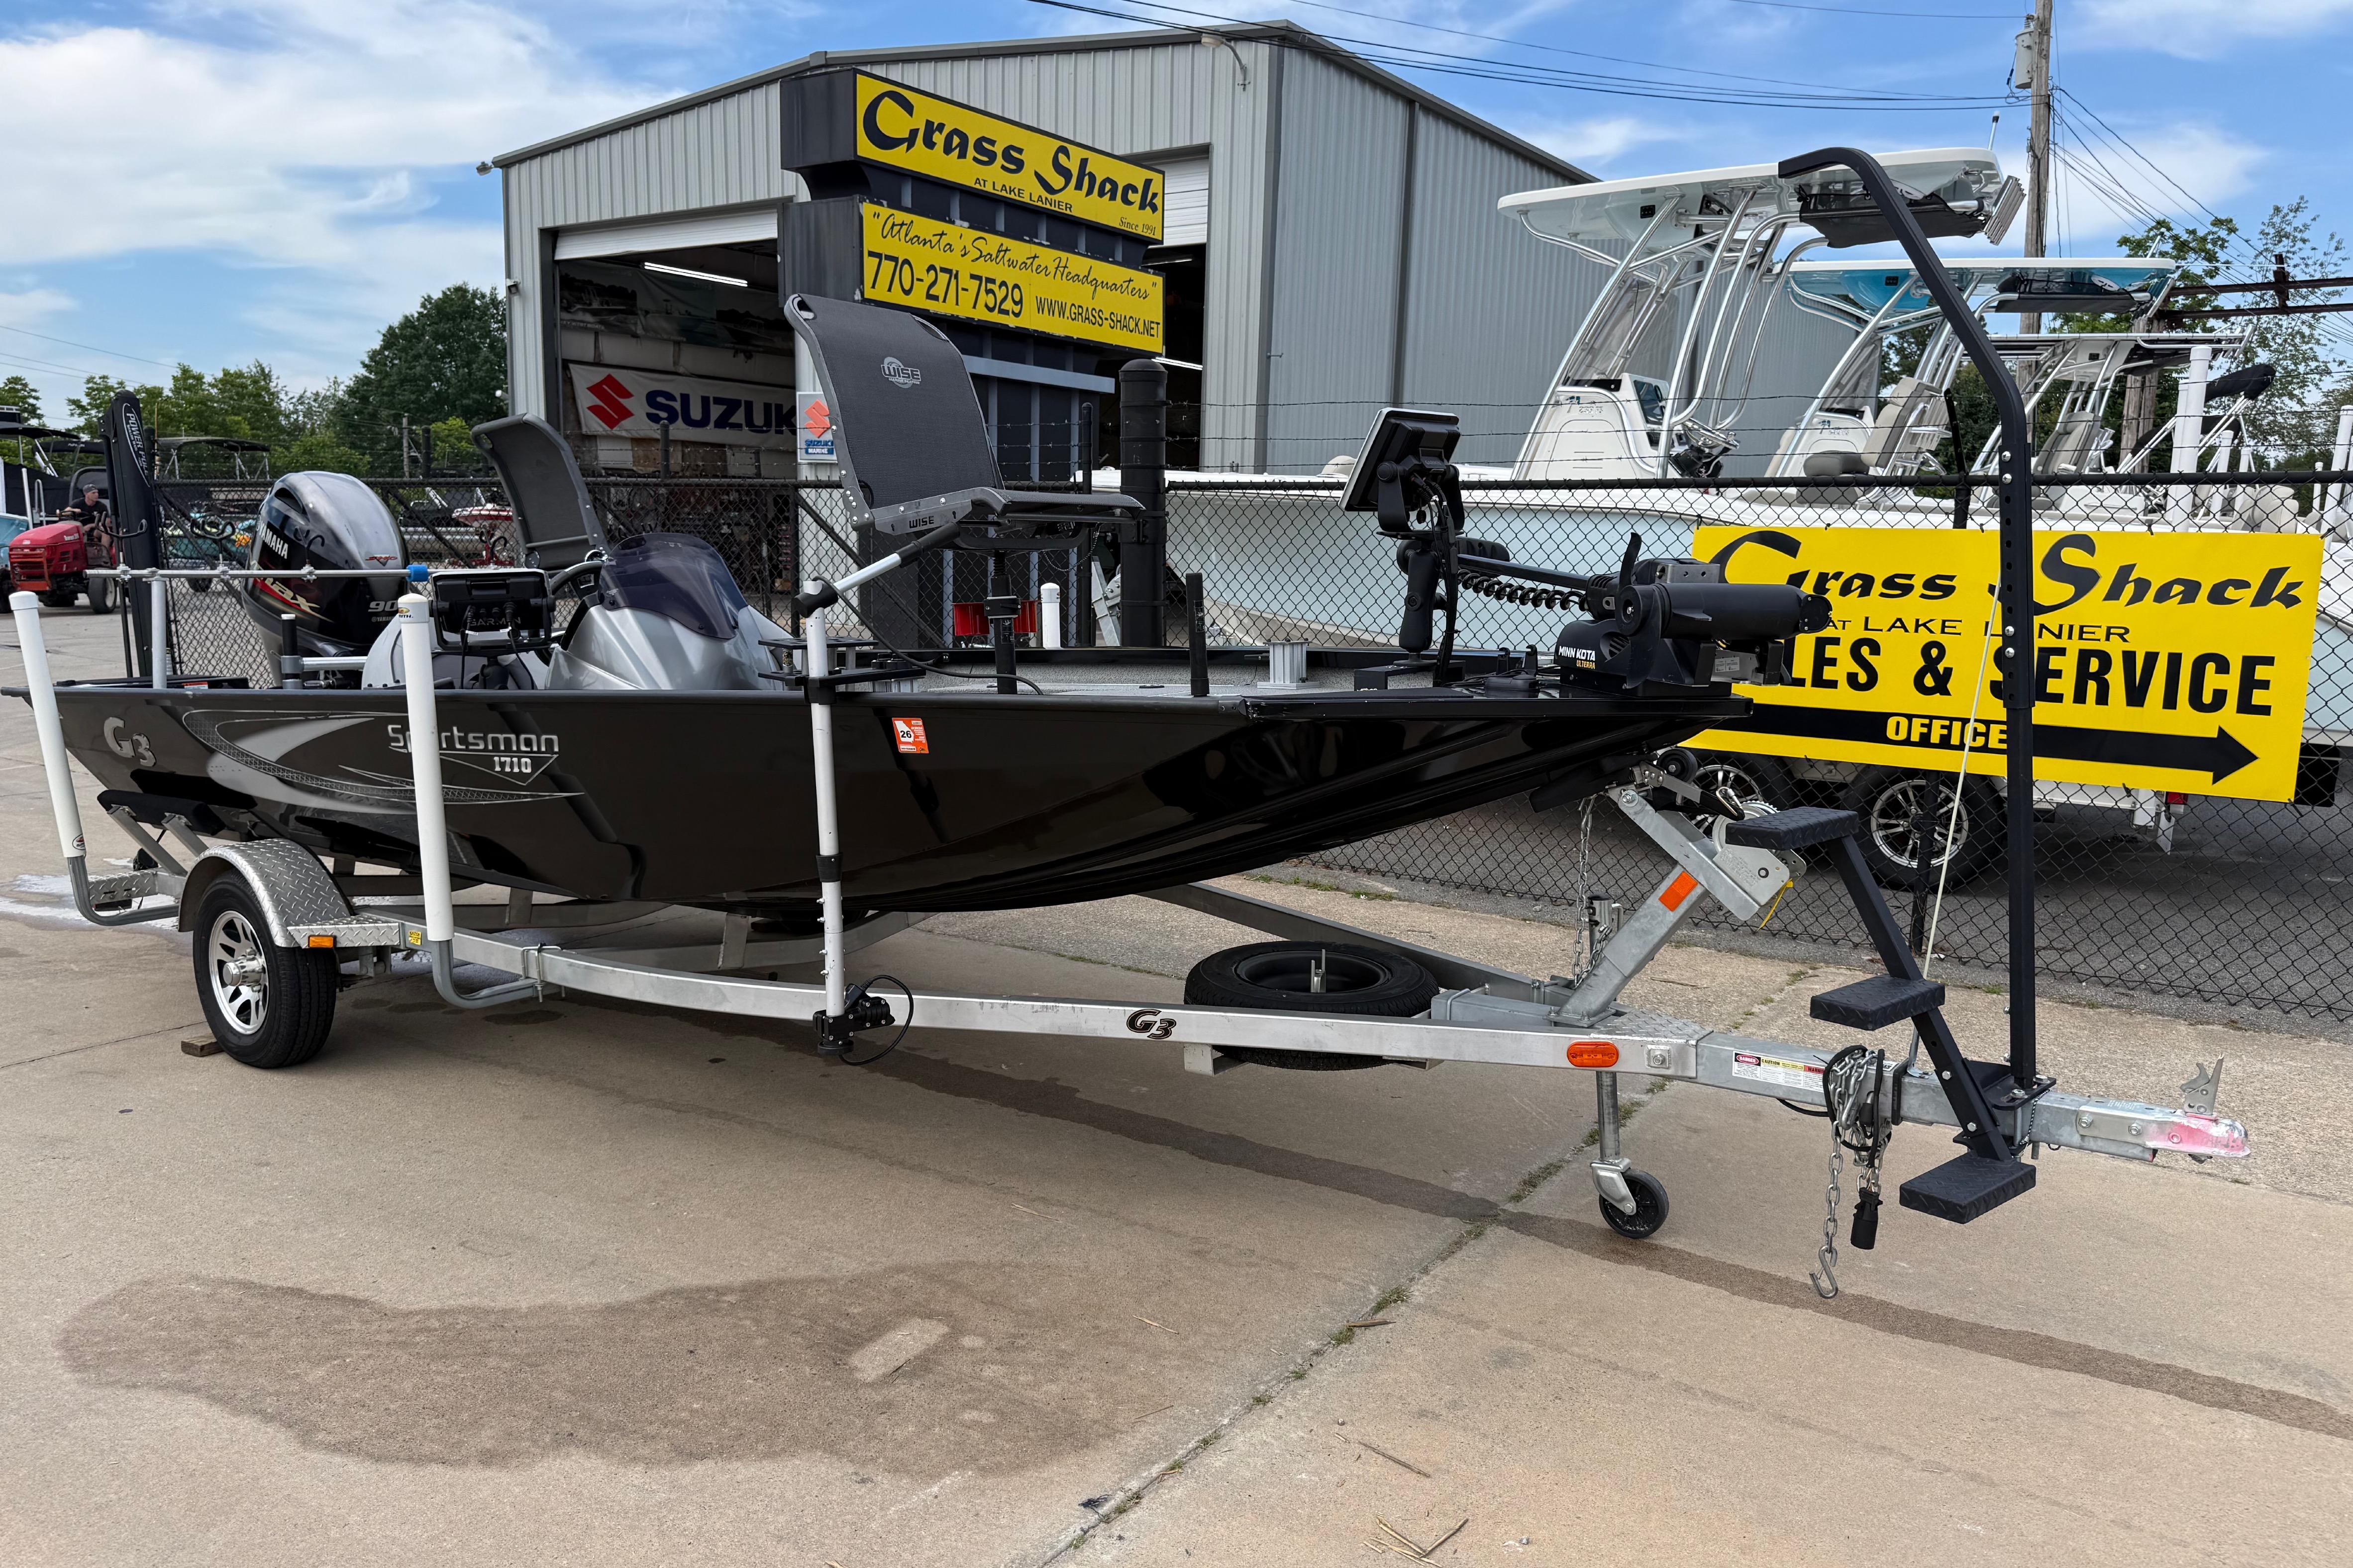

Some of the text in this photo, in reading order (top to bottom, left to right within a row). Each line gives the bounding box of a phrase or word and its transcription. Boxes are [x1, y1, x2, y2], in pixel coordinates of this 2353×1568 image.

[863, 90, 1158, 214] Grass Shack
[974, 177, 1073, 213] AT LAKE LANIER
[1119, 216, 1156, 236] Since 1991
[971, 237, 1052, 277] Saltwater
[867, 250, 1160, 338] 770-271-7529 WWW.GRASS-SHACK.NET
[881, 364, 921, 382] WISE
[646, 390, 796, 436] SUZUK
[126, 413, 143, 448] POWER
[909, 515, 934, 529] WISE
[259, 522, 289, 559] YAMAHA
[1708, 530, 2304, 616] Grass Shack
[368, 600, 398, 612] 90
[470, 617, 521, 626] GARMN
[1825, 616, 2131, 643] AT LAKE LNIER
[1558, 645, 1596, 661] MINN KOTA
[1576, 660, 1595, 670] ULTERRA
[1784, 636, 1881, 692] LES
[1913, 640, 1953, 696] &
[103, 716, 157, 767] G3
[388, 724, 559, 753] Srtsman
[1886, 716, 2007, 750] OFFICE
[494, 756, 532, 773] 1710
[1126, 1008, 1177, 1040] G3
